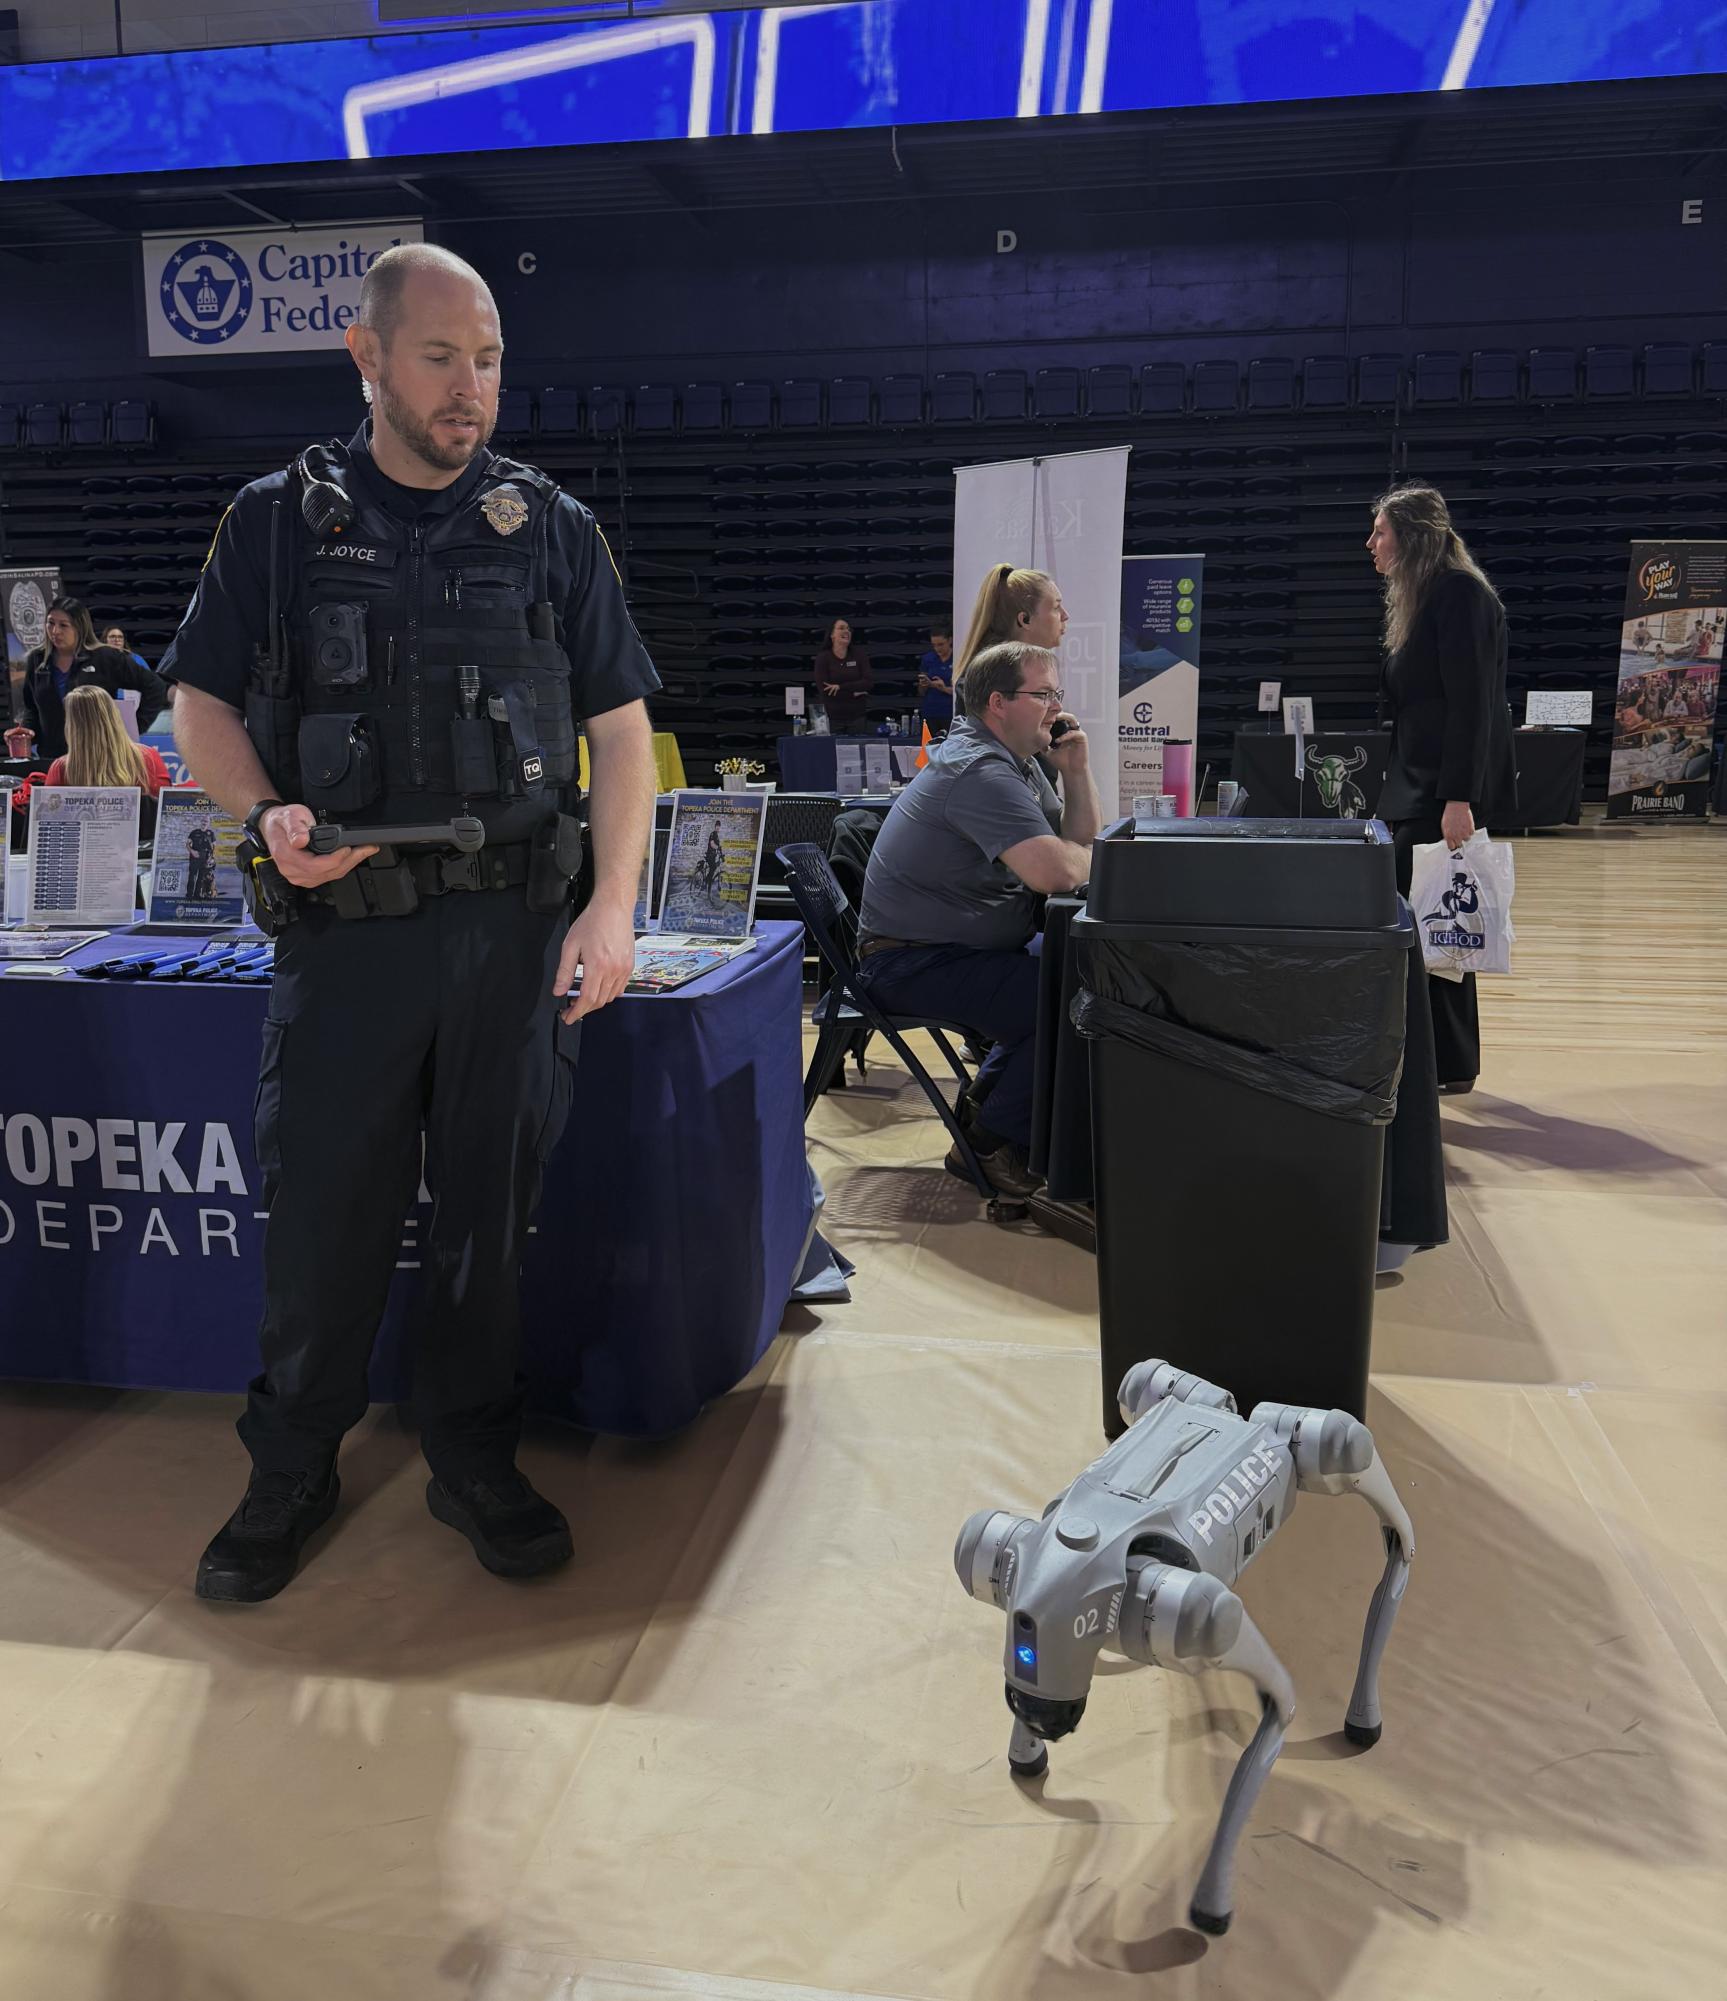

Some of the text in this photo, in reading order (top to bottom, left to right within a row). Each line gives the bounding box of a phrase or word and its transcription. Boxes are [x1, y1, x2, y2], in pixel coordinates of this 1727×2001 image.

[1682, 199, 1703, 225] E
[997, 230, 1017, 254] D
[258, 238, 401, 288] Capit
[518, 252, 537, 275] C
[316, 544, 377, 562] J. JOYCE
[1648, 560, 1670, 575] PLAY
[1641, 565, 1676, 601] your
[1654, 578, 1673, 591] WAY
[1118, 725, 1170, 736] Central
[524, 762, 540, 775] TQ
[1123, 760, 1163, 770] Careers
[64, 797, 124, 806] TOPEKA POLICE
[723, 806, 759, 814] DEPARTMENT
[1631, 793, 1685, 812] PRAIRIE BAND
[0, 1113, 249, 1195] OPEKA
[1187, 1439, 1282, 1546] POLICE
[1073, 1608, 1099, 1639] 02
